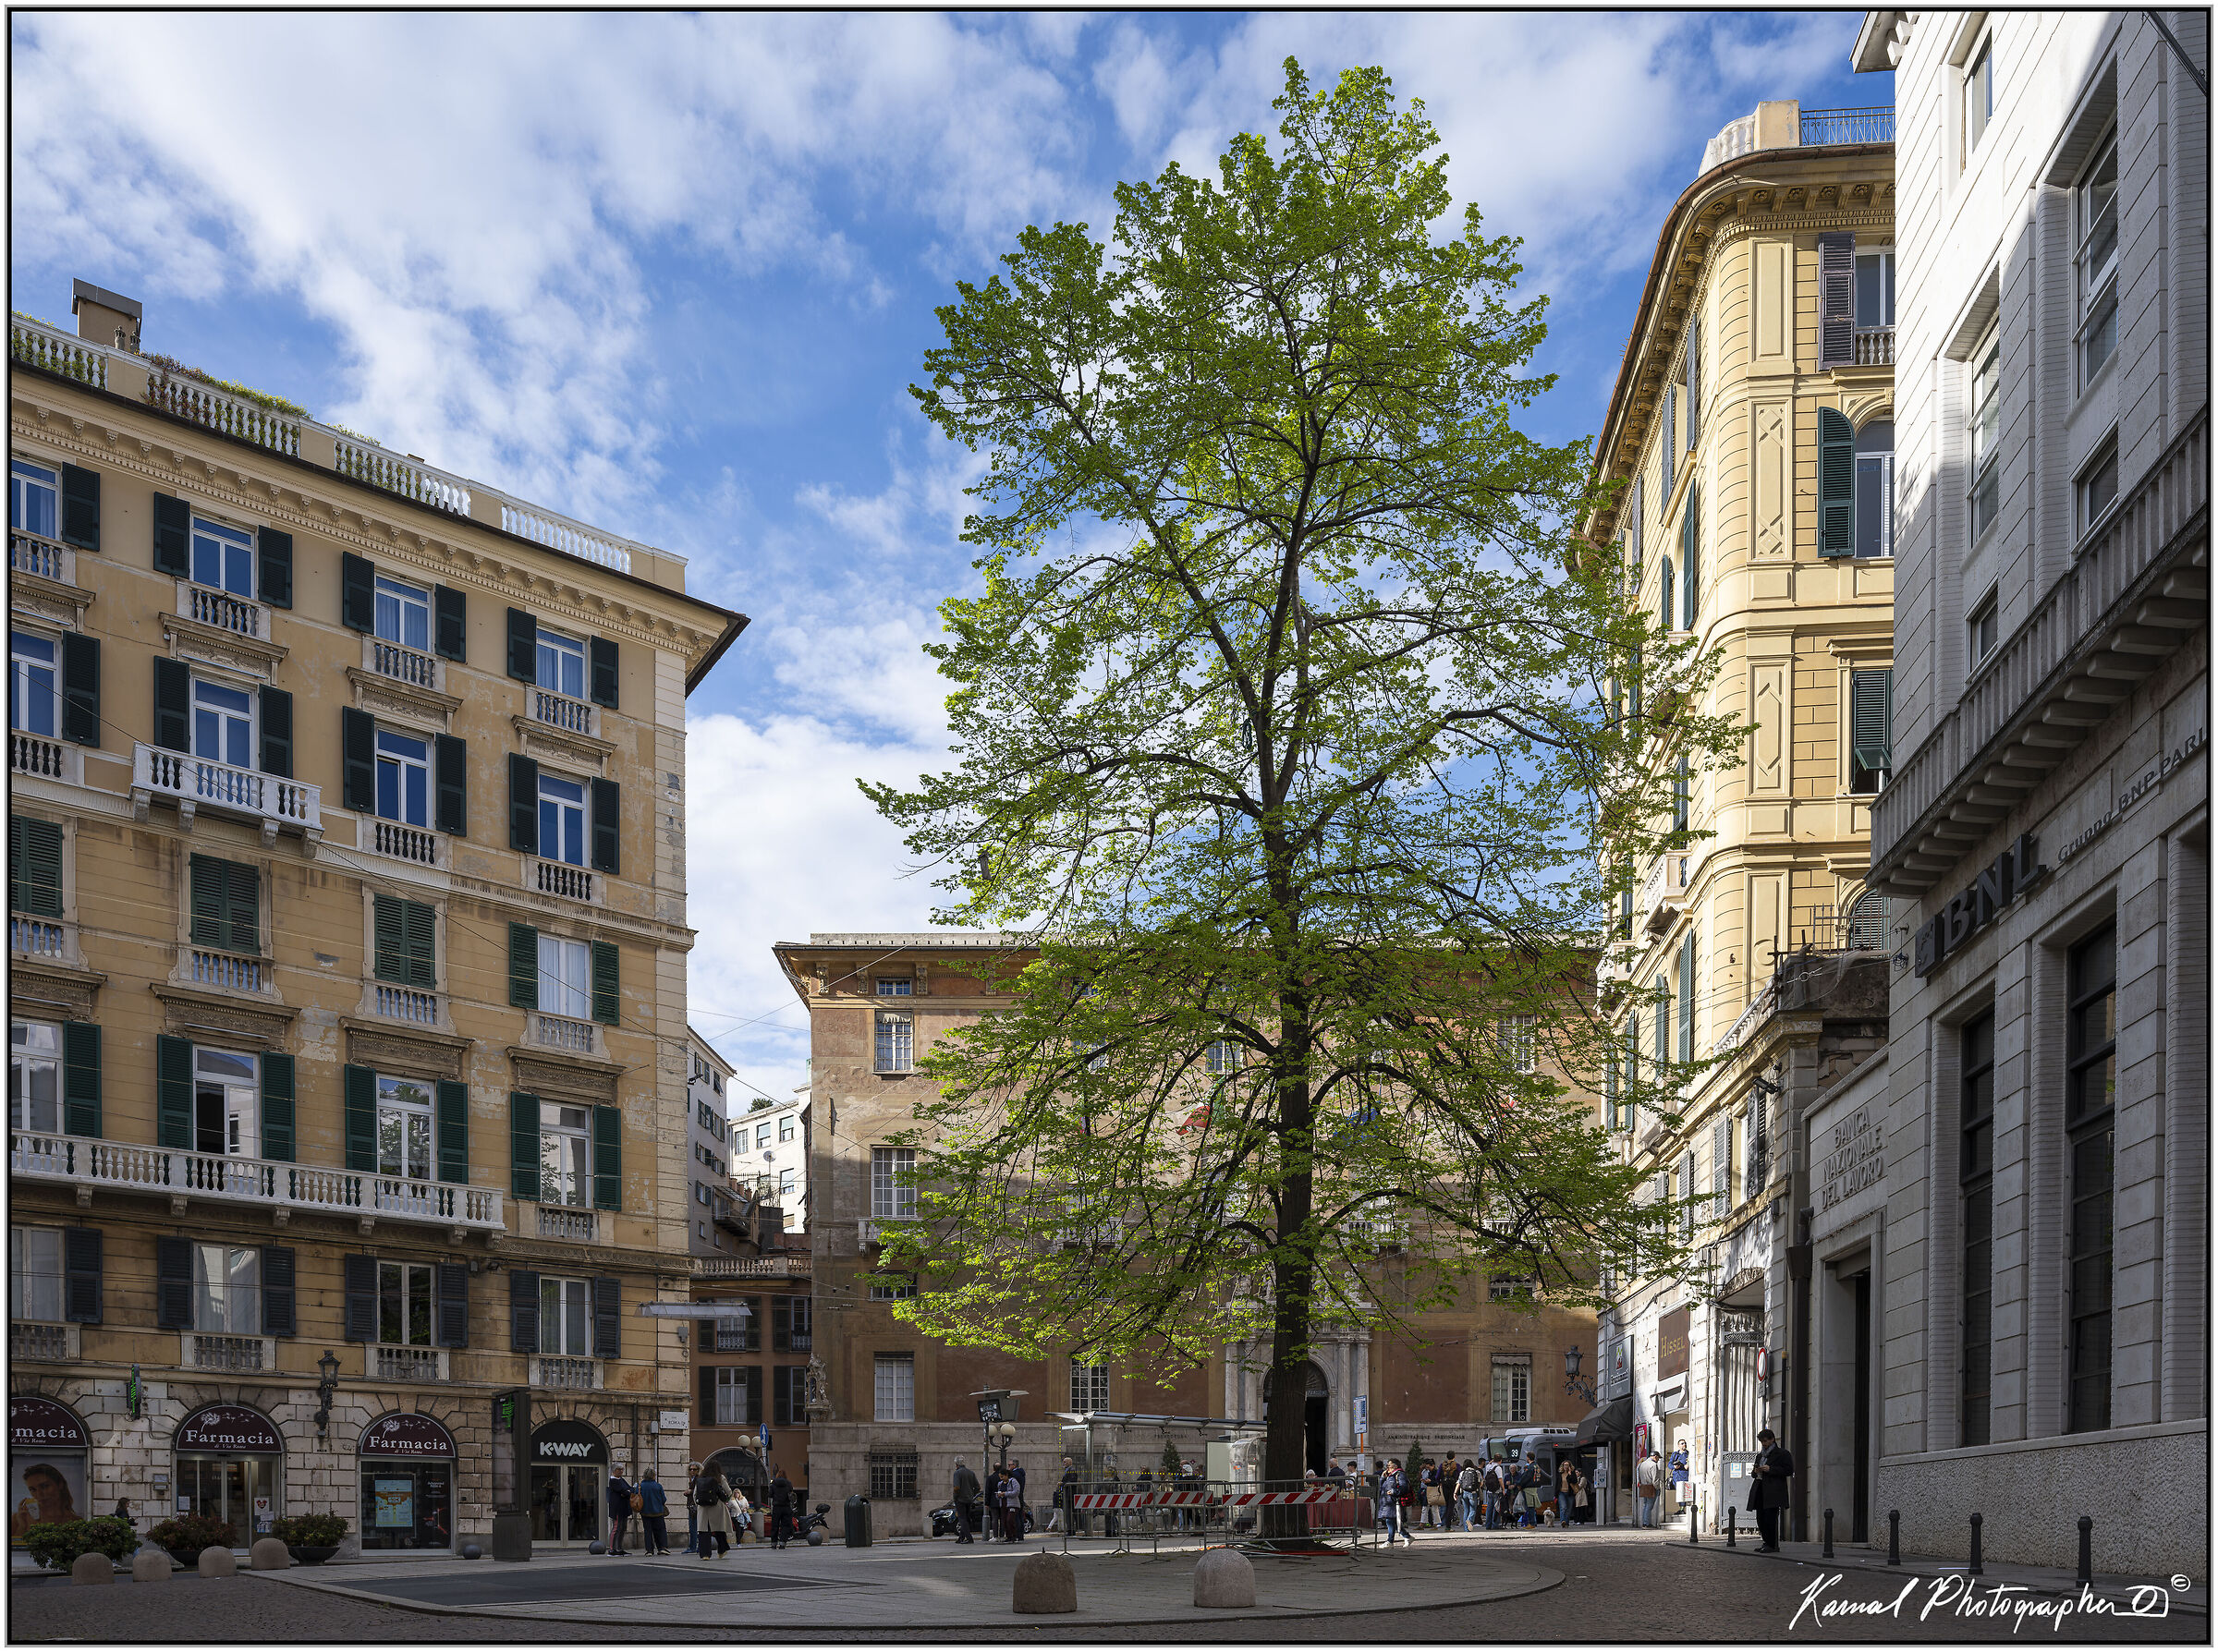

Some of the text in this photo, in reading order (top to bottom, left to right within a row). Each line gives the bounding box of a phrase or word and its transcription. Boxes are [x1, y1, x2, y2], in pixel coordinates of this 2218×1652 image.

[2057, 810, 2113, 864] Gruppo
[2118, 770, 2157, 813] BNP
[1944, 834, 2048, 953] BNL
[1823, 1125, 1883, 1183] NAZIONALE
[1834, 1107, 1871, 1148] BANCA
[1822, 1156, 1883, 1209] DEL LAVORO
[185, 1429, 274, 1444] Farmacia
[369, 1436, 447, 1450] Farmacia
